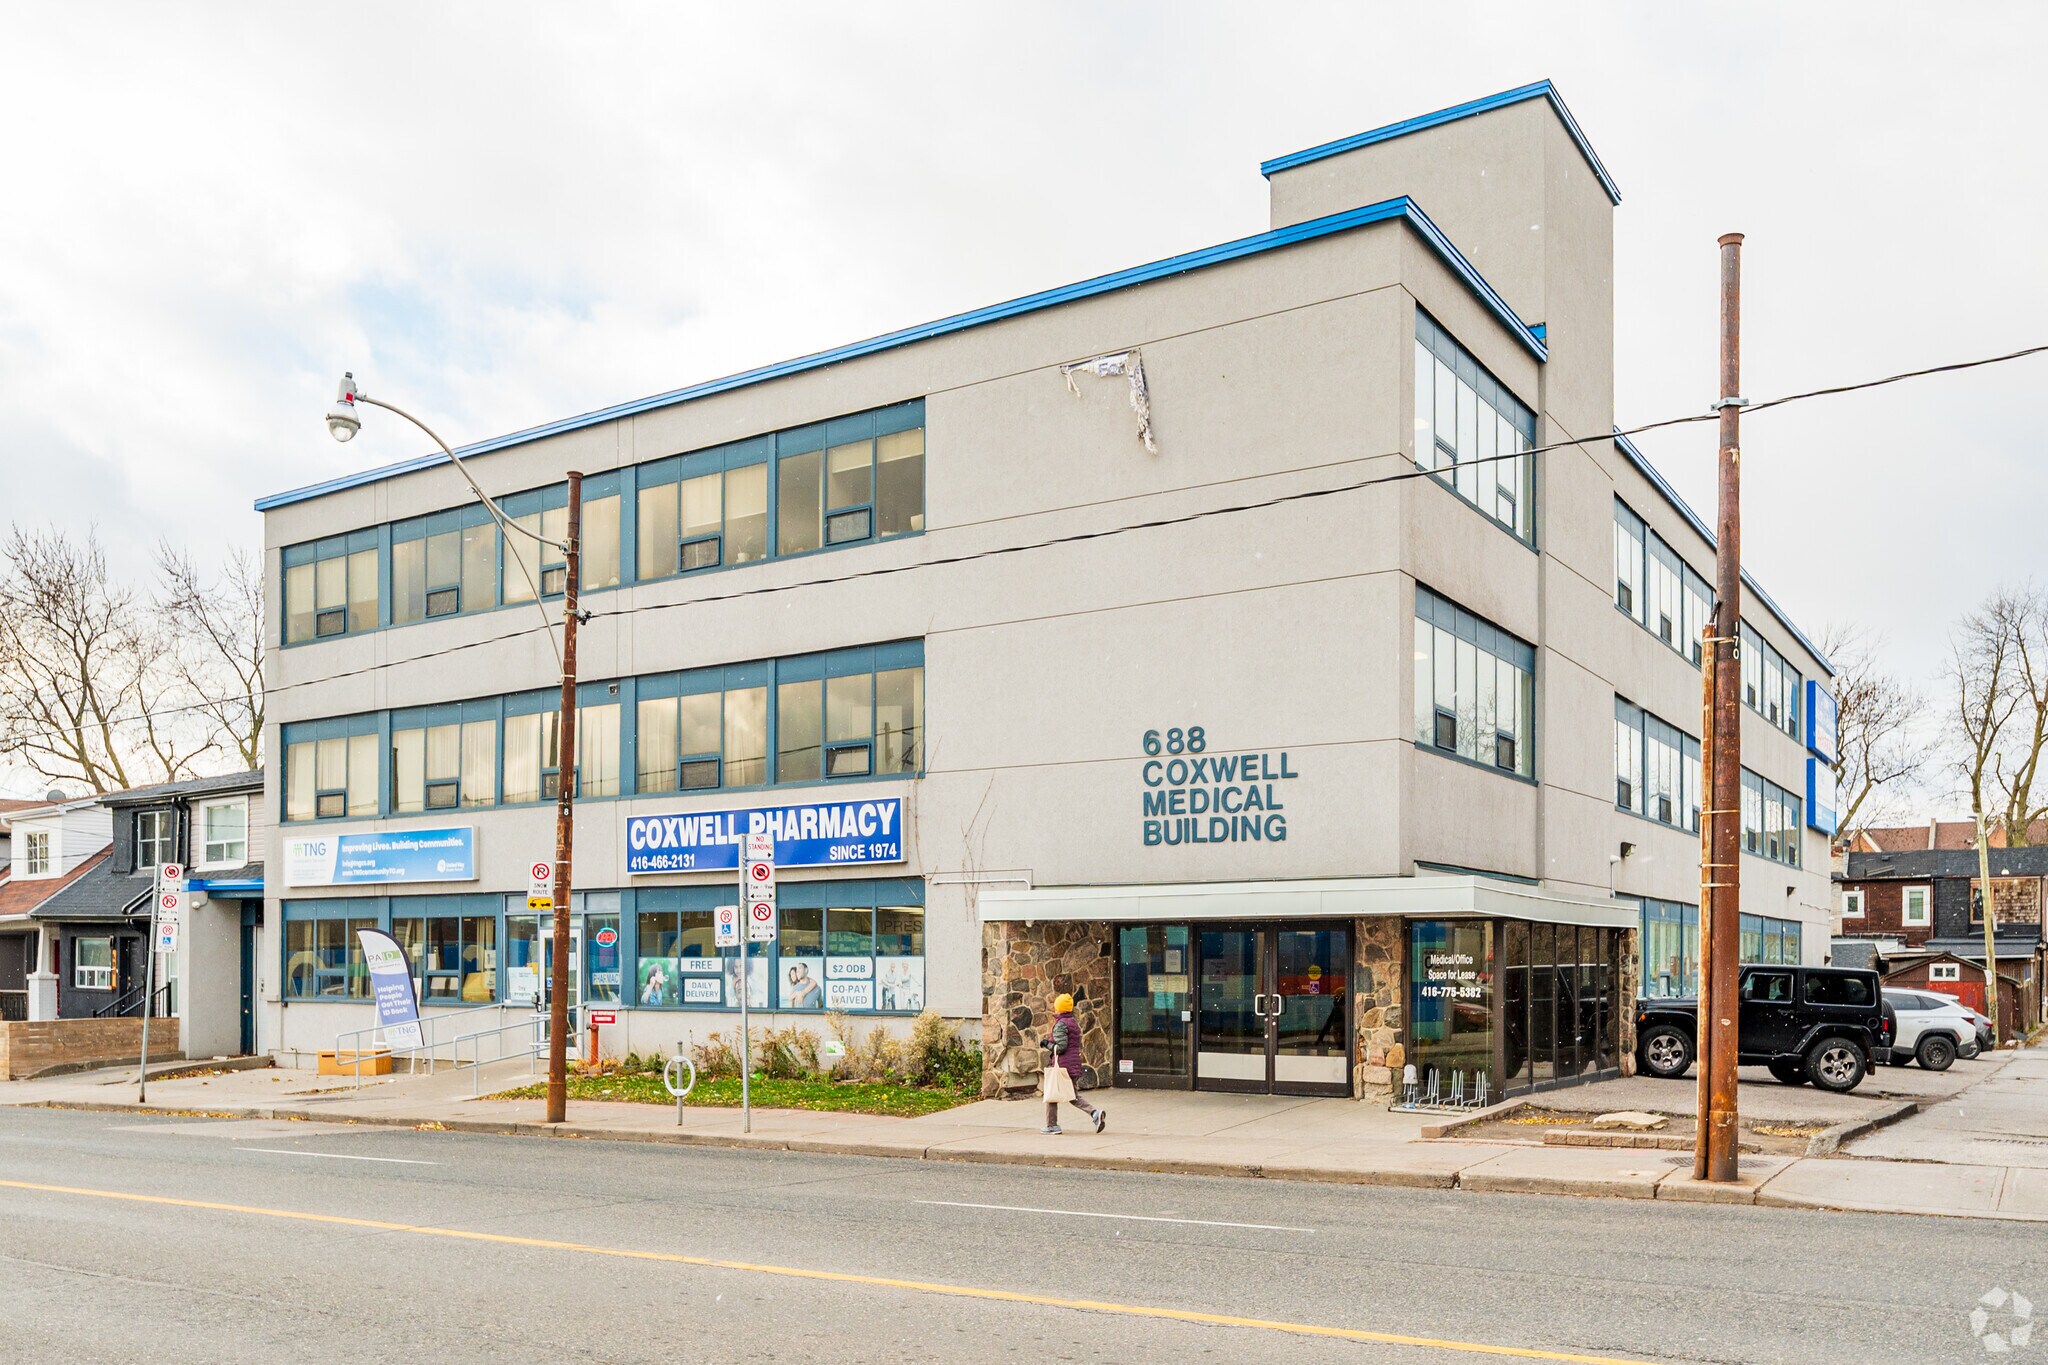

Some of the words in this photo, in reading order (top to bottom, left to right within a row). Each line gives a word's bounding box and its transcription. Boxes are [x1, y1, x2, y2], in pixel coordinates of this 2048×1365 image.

[1732, 621, 1740, 660] 170
[1142, 725, 1206, 756] 688
[1142, 752, 1299, 787] COXWELL
[1143, 783, 1284, 817] MEDICAL
[631, 814, 740, 850] COXWELL
[749, 802, 897, 843] PHARMACY
[1143, 813, 1287, 846] BUILDING
[303, 842, 326, 856] TNG
[748, 843, 773, 851] STANDING
[829, 844, 866, 861] SINCE
[868, 842, 897, 858] 1974
[630, 853, 696, 870] 416-466-2131
[598, 930, 616, 943] OPEN
[690, 961, 713, 970] FREE
[1430, 954, 1474, 965] Medical/Office
[832, 964, 844, 973] $2
[846, 964, 866, 973] ODB
[1428, 969, 1447, 982] Space
[1447, 969, 1457, 980] for
[1457, 969, 1476, 980] Lease
[378, 984, 405, 994] Helping
[691, 981, 713, 990] DAILY
[831, 984, 867, 994] CO-PAY
[379, 992, 403, 1001] People
[685, 990, 719, 998] DELIVERY
[1421, 986, 1481, 998] 416-775-5382
[831, 994, 868, 1005] WAIVED
[397, 1025, 416, 1035] TNG
